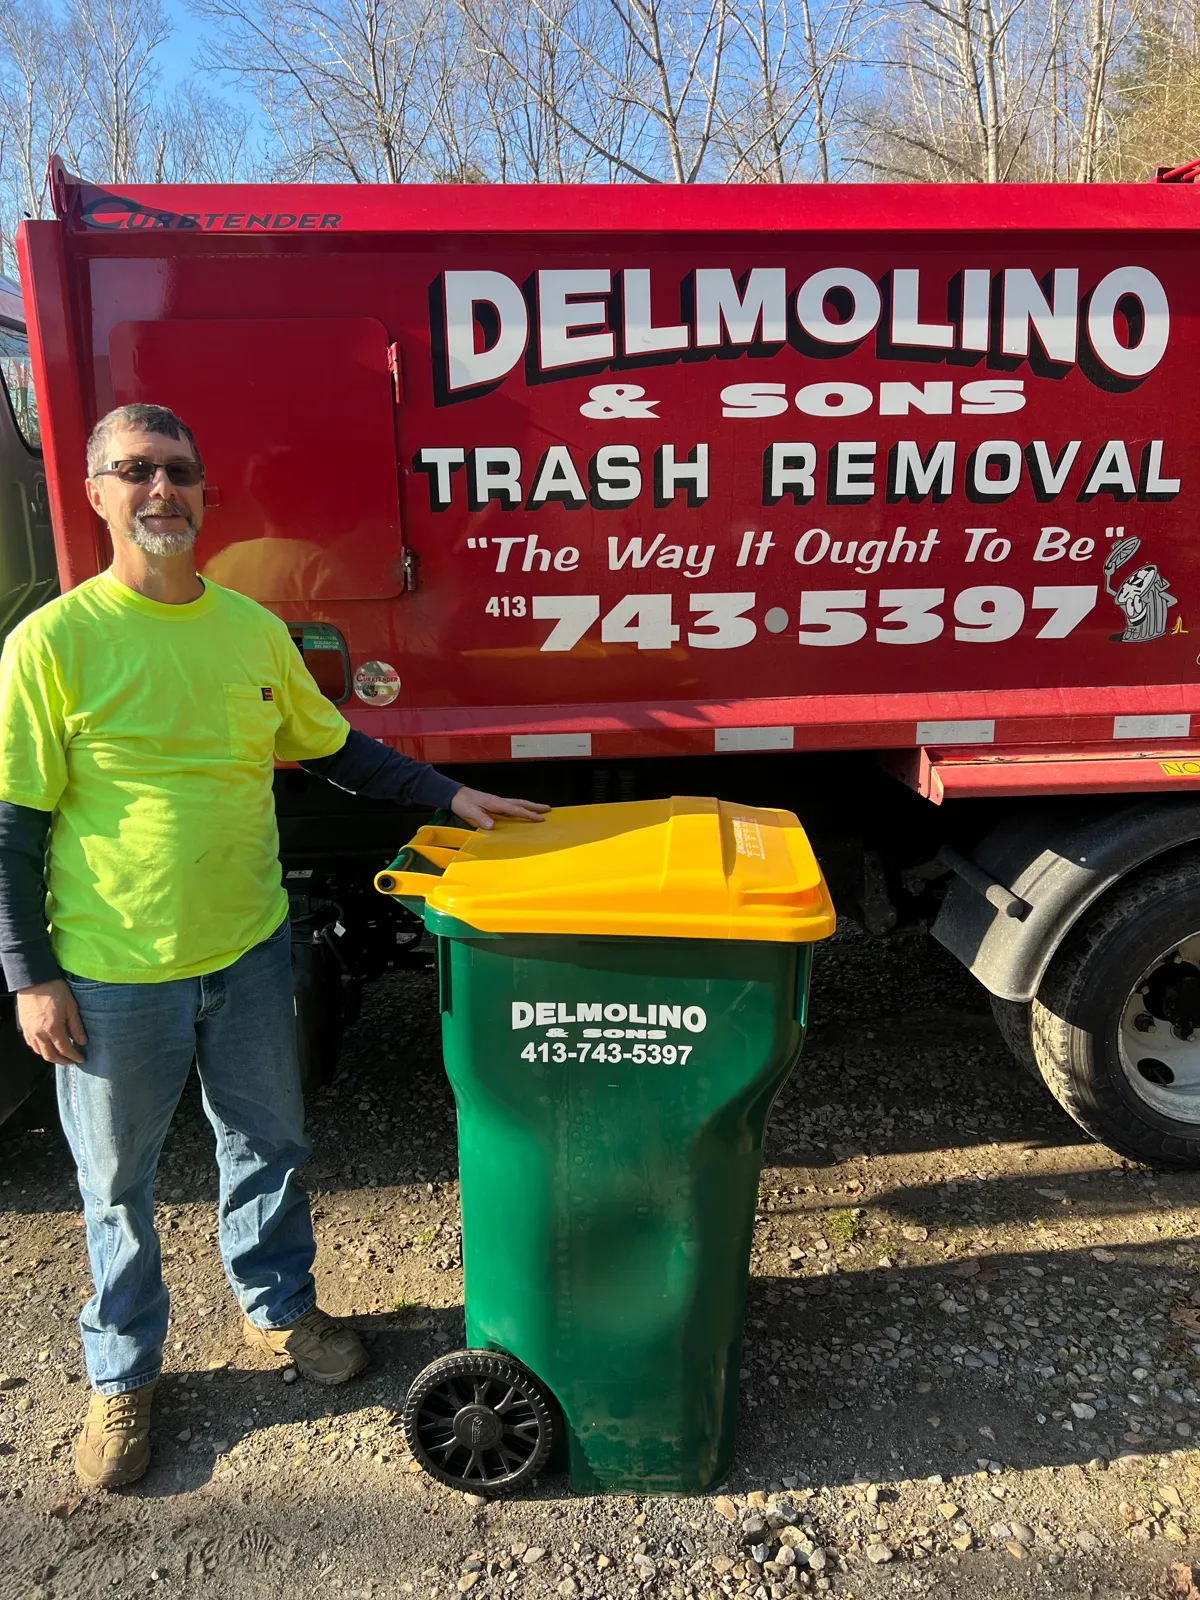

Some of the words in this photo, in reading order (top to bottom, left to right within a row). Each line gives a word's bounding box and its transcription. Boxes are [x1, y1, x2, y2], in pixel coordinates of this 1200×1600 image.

[80, 196, 342, 230] CURBTENDER
[436, 267, 1170, 394] DELMOLINO
[579, 384, 661, 420] &
[720, 380, 1027, 418] SONS
[418, 443, 709, 504] TRASH
[770, 440, 1181, 498] REMOVAL
[608, 534, 716, 578] Way
[735, 532, 776, 567] It
[795, 527, 941, 574] Ought
[965, 528, 1012, 563] To
[485, 595, 527, 619] 413
[512, 1001, 707, 1033] DELMOLINO
[546, 1027, 569, 1038] &
[582, 1028, 668, 1040] SONS
[520, 1041, 693, 1066] 413-743-5397
